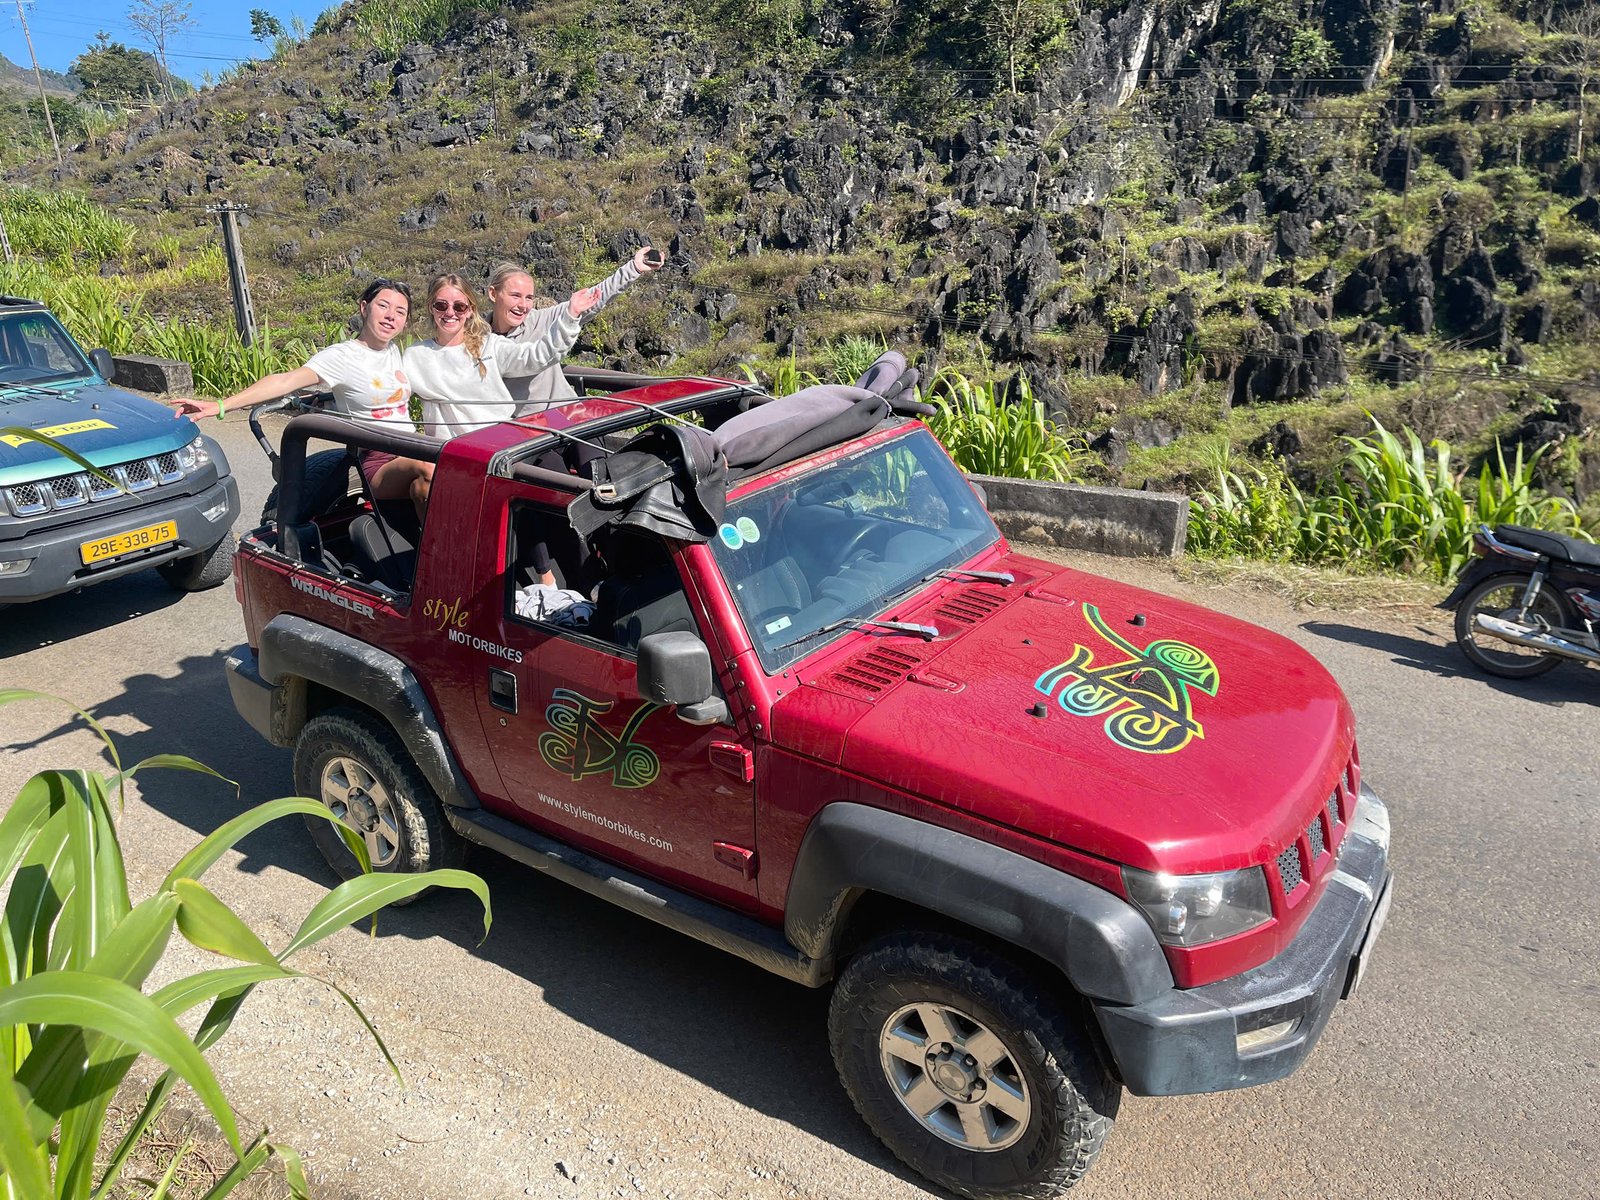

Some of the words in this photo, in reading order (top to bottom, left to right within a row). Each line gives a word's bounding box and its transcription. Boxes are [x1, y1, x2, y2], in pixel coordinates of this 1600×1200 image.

[13, 430, 56, 442] Jp
[62, 422, 99, 432] Tour
[91, 526, 170, 557] 29E-338.75
[290, 577, 376, 620] WRANGLER
[423, 597, 469, 631] style
[448, 628, 523, 664] MOTORBIKES
[537, 792, 673, 852] www.stylemotorbikes.com
